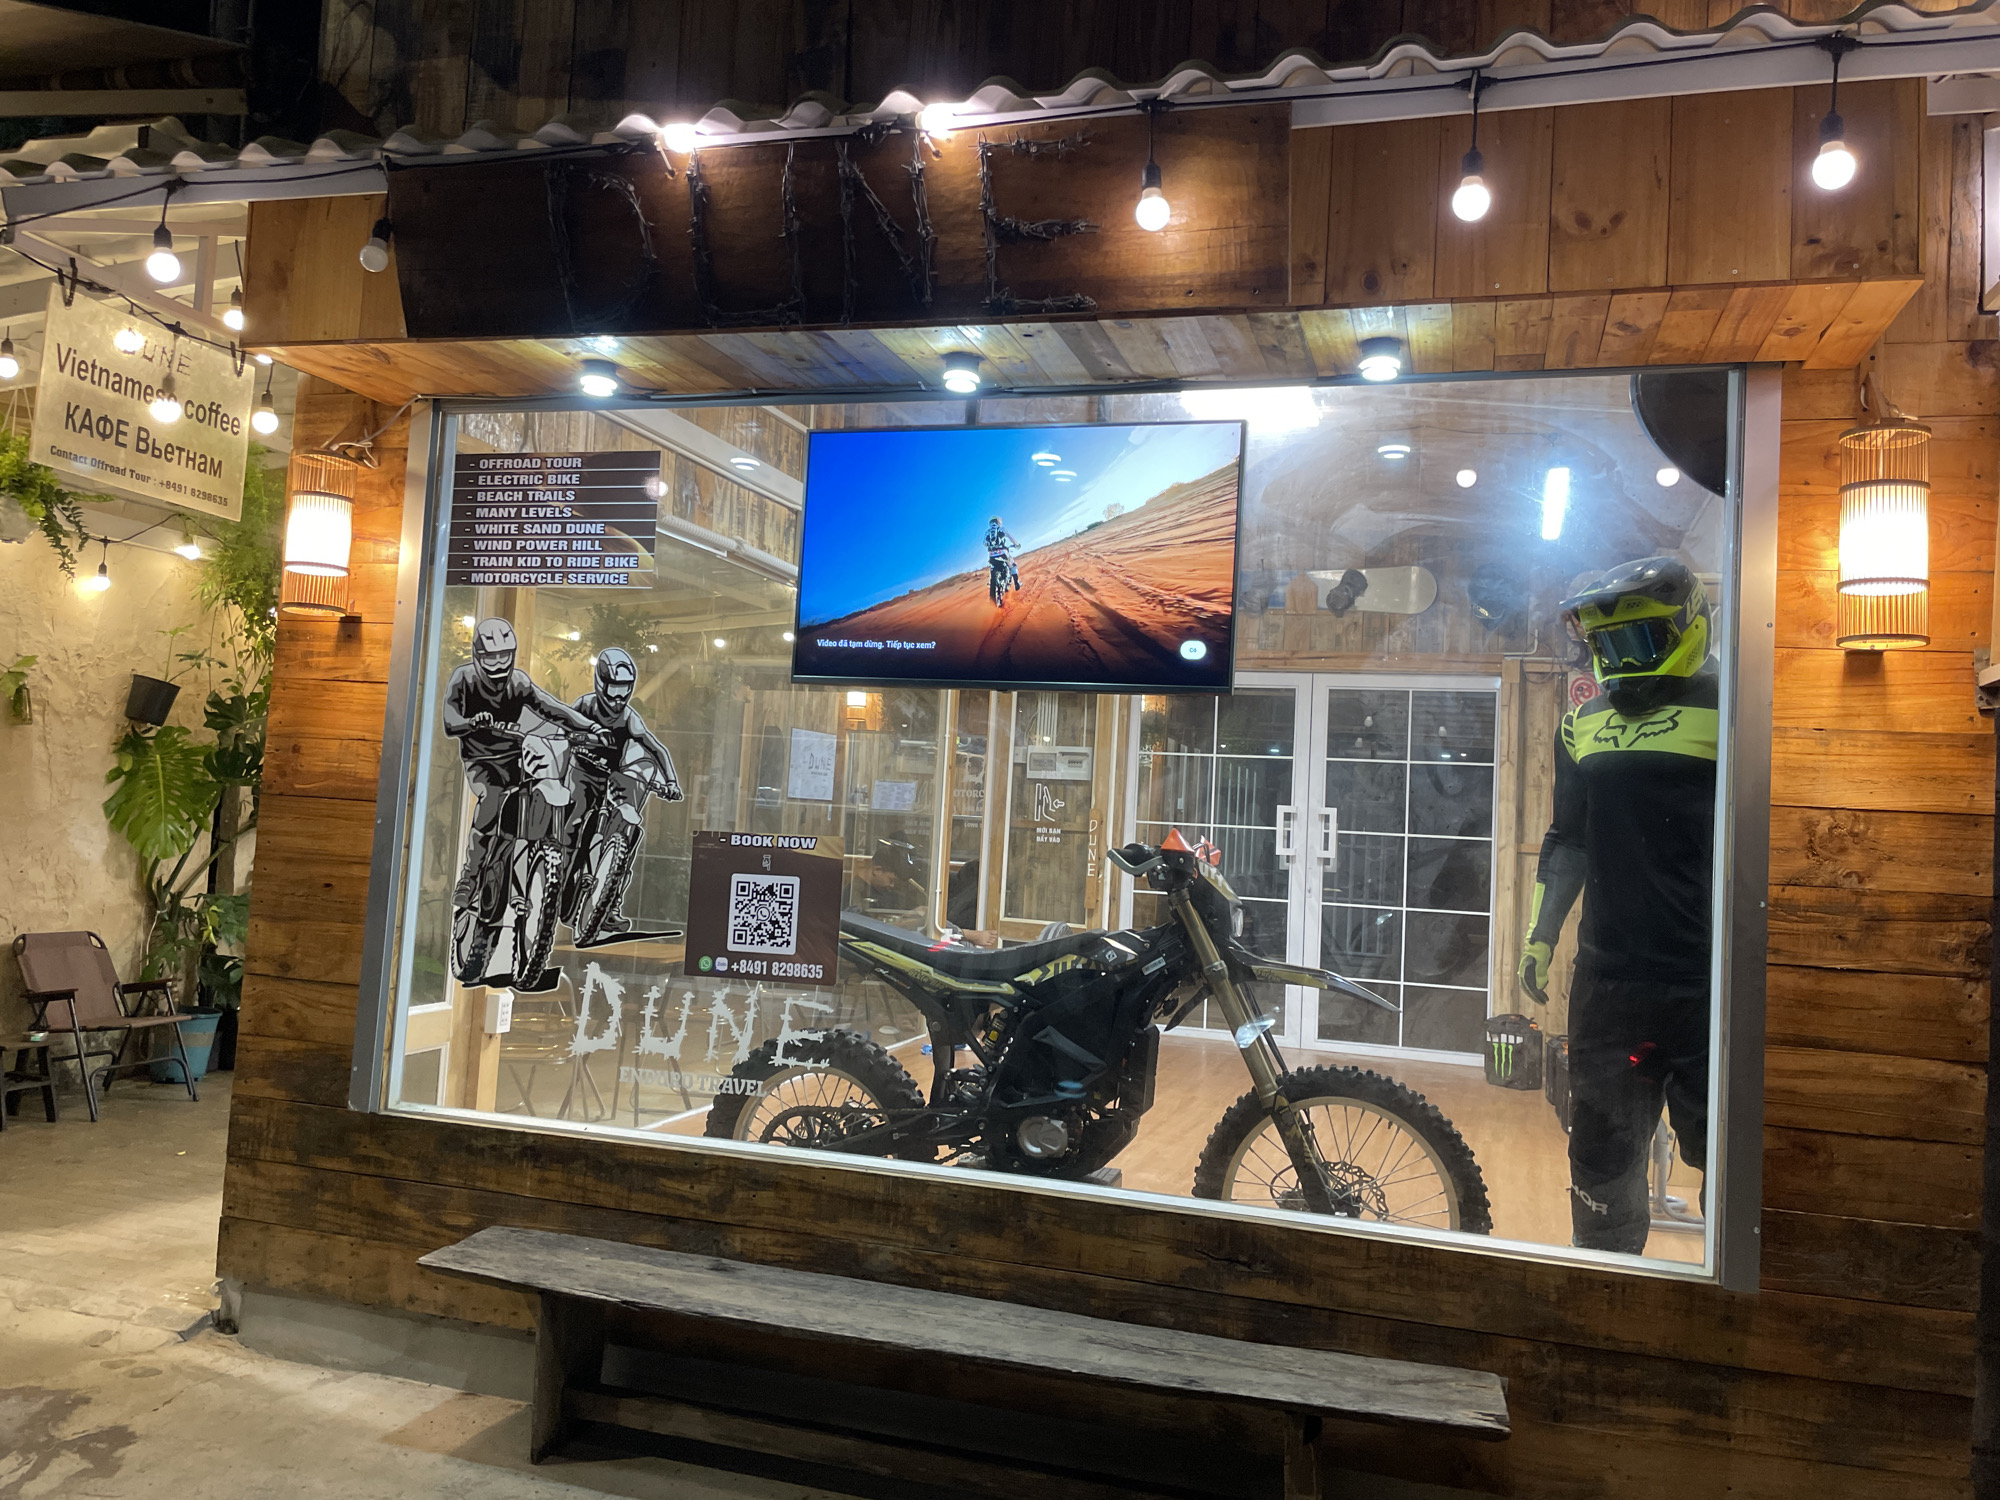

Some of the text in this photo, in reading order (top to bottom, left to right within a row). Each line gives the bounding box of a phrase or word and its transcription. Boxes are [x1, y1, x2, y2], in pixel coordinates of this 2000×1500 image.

[544, 132, 1101, 335] DUNE
[184, 399, 241, 436] coffee
[64, 402, 130, 449] КАФЕ
[479, 457, 582, 470] OFFROAD TOUR
[50, 445, 229, 507] Contact Offroad Tour +8491 8298635
[478, 473, 580, 486] ELECTRIC BIKE
[477, 490, 576, 503] BEACH TRAILS
[475, 506, 573, 519] MANY LEVELS
[475, 523, 606, 535] WHITE SAND DUNE
[473, 540, 603, 552] WIND POWER HILL
[472, 556, 639, 568] TRAIN KID TO RIDE BIKE
[471, 573, 629, 585] MOTORCYCLE SERVICE
[817, 639, 837, 647] Video
[838, 639, 848, 647] đã
[849, 640, 863, 649] tạm
[916, 641, 936, 649] xem?
[808, 752, 833, 771] DUNE
[731, 834, 817, 849] BOOK NOW
[1088, 819, 1098, 877] DUNE
[731, 959, 824, 979] +8491 8298635
[565, 961, 833, 1069] DUNE
[619, 1065, 767, 1098] ENDURO TRAVEL
